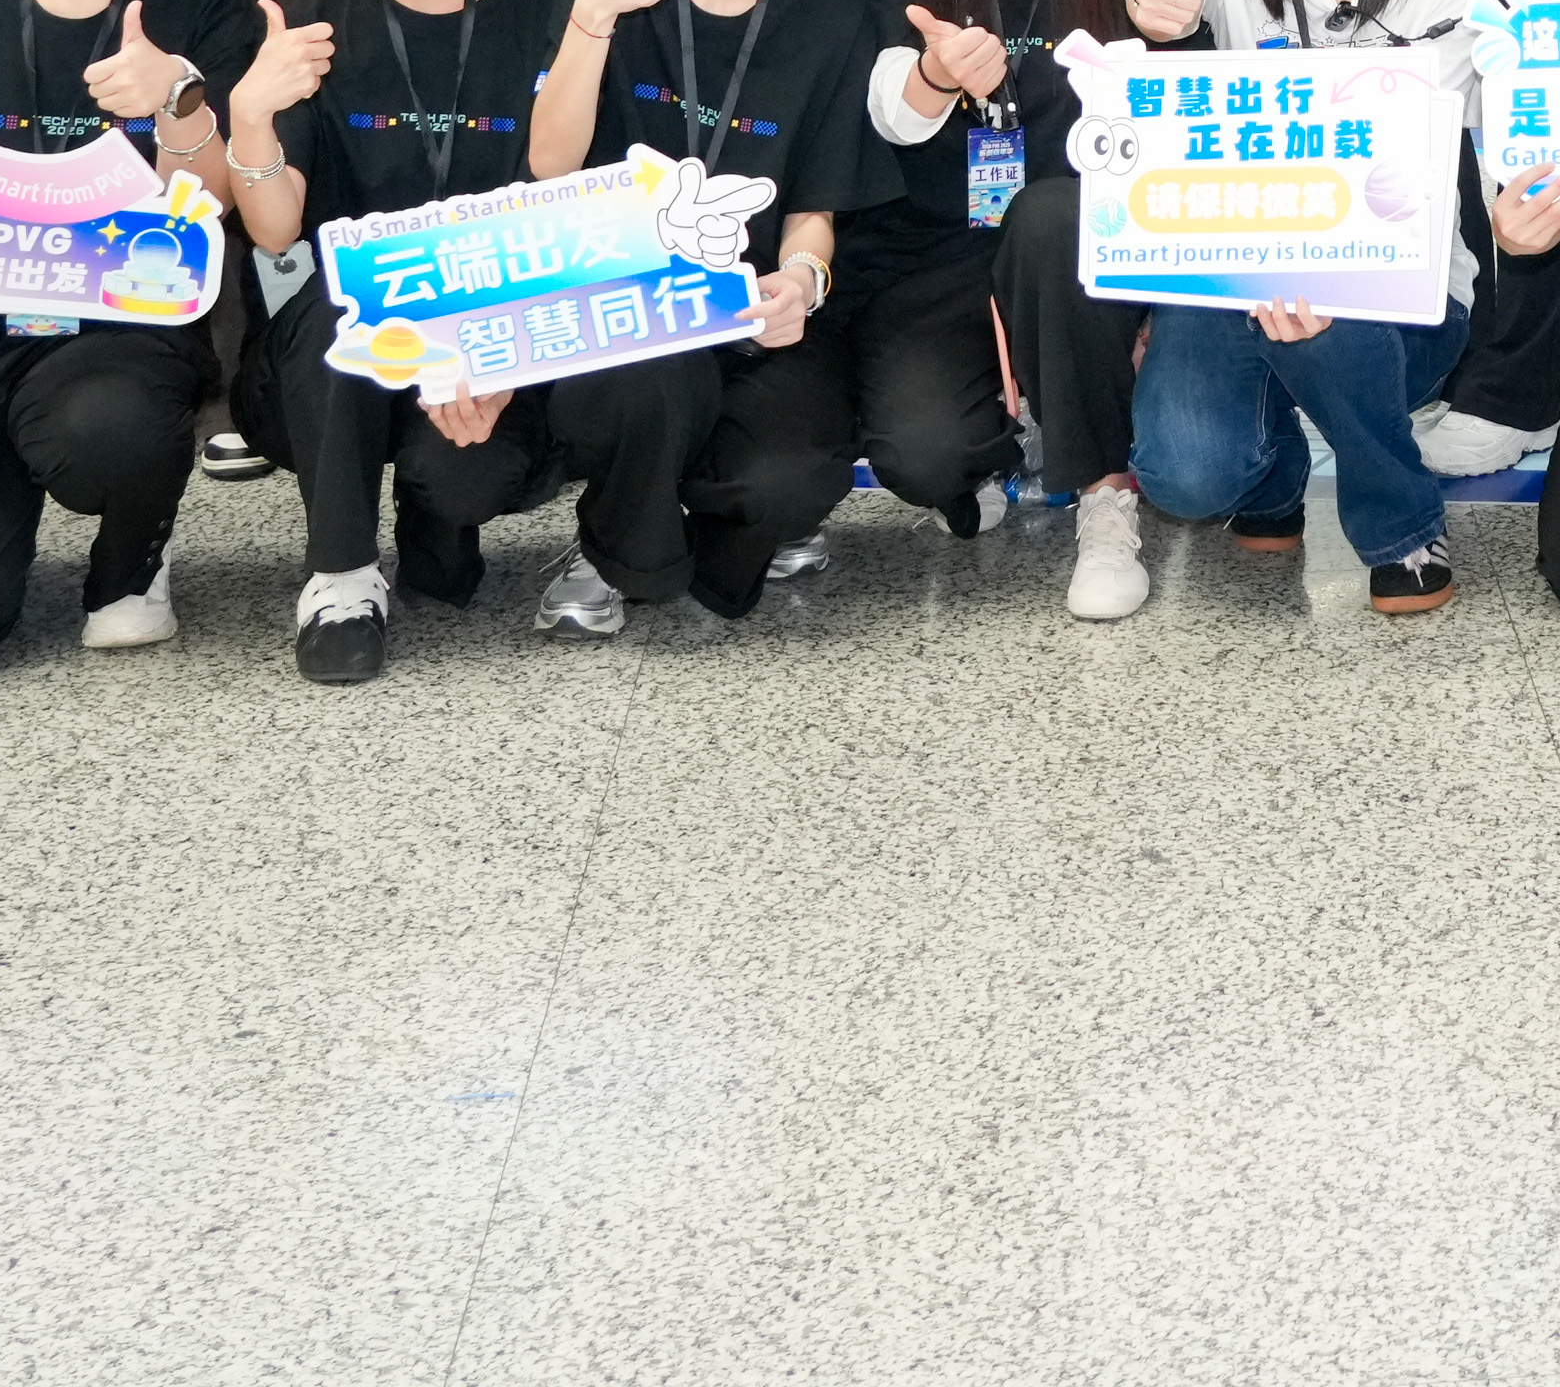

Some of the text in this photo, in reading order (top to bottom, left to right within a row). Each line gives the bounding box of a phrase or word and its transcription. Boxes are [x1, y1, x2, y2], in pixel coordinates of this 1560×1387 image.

[1127, 76, 1314, 118] 智慧出行
[74, 116, 101, 128] PVG
[1184, 120, 1373, 162] 正在加载
[44, 184, 93, 205] from
[95, 159, 138, 197] PVG
[974, 166, 1019, 181] 工作证
[328, 169, 634, 248] Fly Smart Start from PVG
[373, 212, 631, 309] 云端出发
[1096, 238, 1420, 266] Smart journey is loading...
[457, 272, 712, 377] 智慧同行
